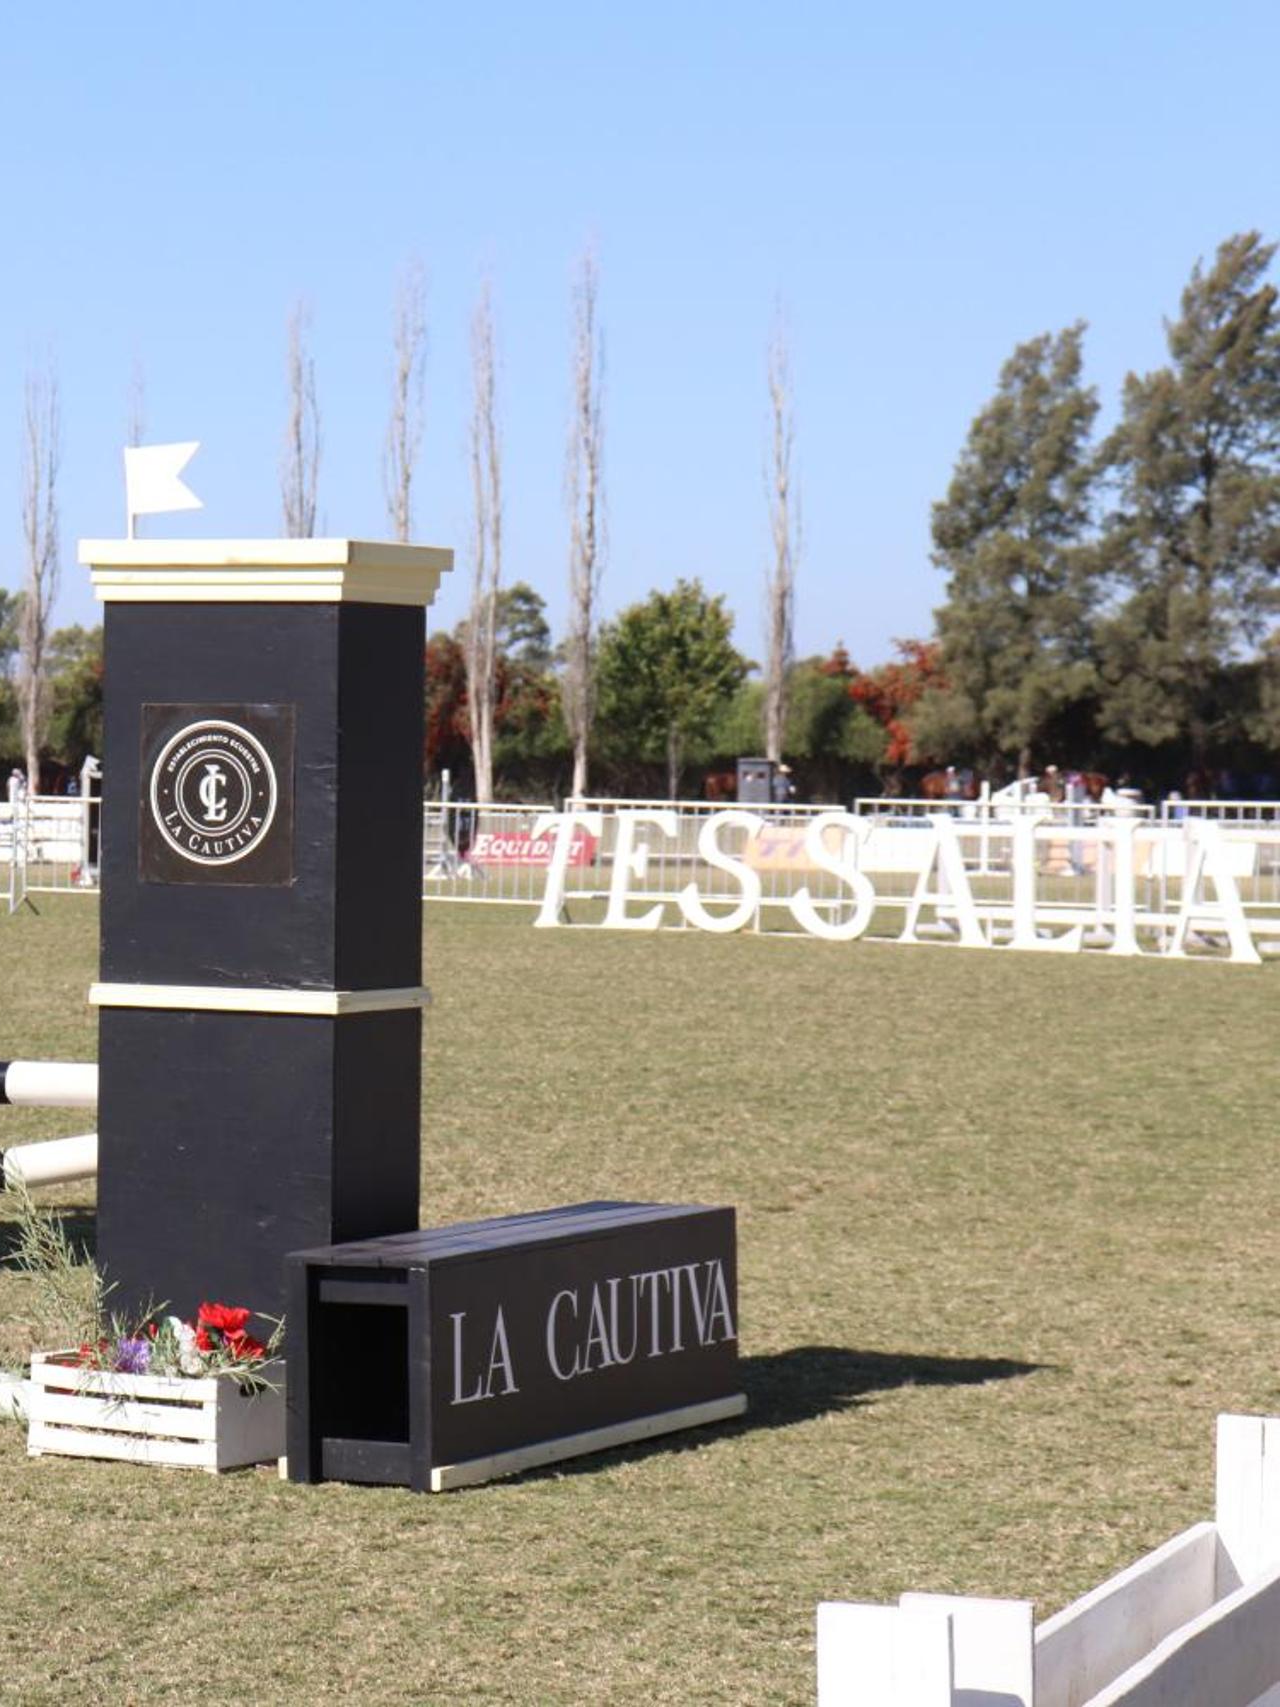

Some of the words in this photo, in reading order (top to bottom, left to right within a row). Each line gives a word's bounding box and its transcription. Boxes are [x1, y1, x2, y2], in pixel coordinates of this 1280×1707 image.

[164, 810, 181, 838] LA
[188, 816, 263, 855] CAUTIVA
[472, 833, 584, 856] EQUIDT
[532, 810, 1262, 964] TESSALIA
[449, 1304, 519, 1406] LA
[546, 1259, 737, 1381] CAUTIVA
